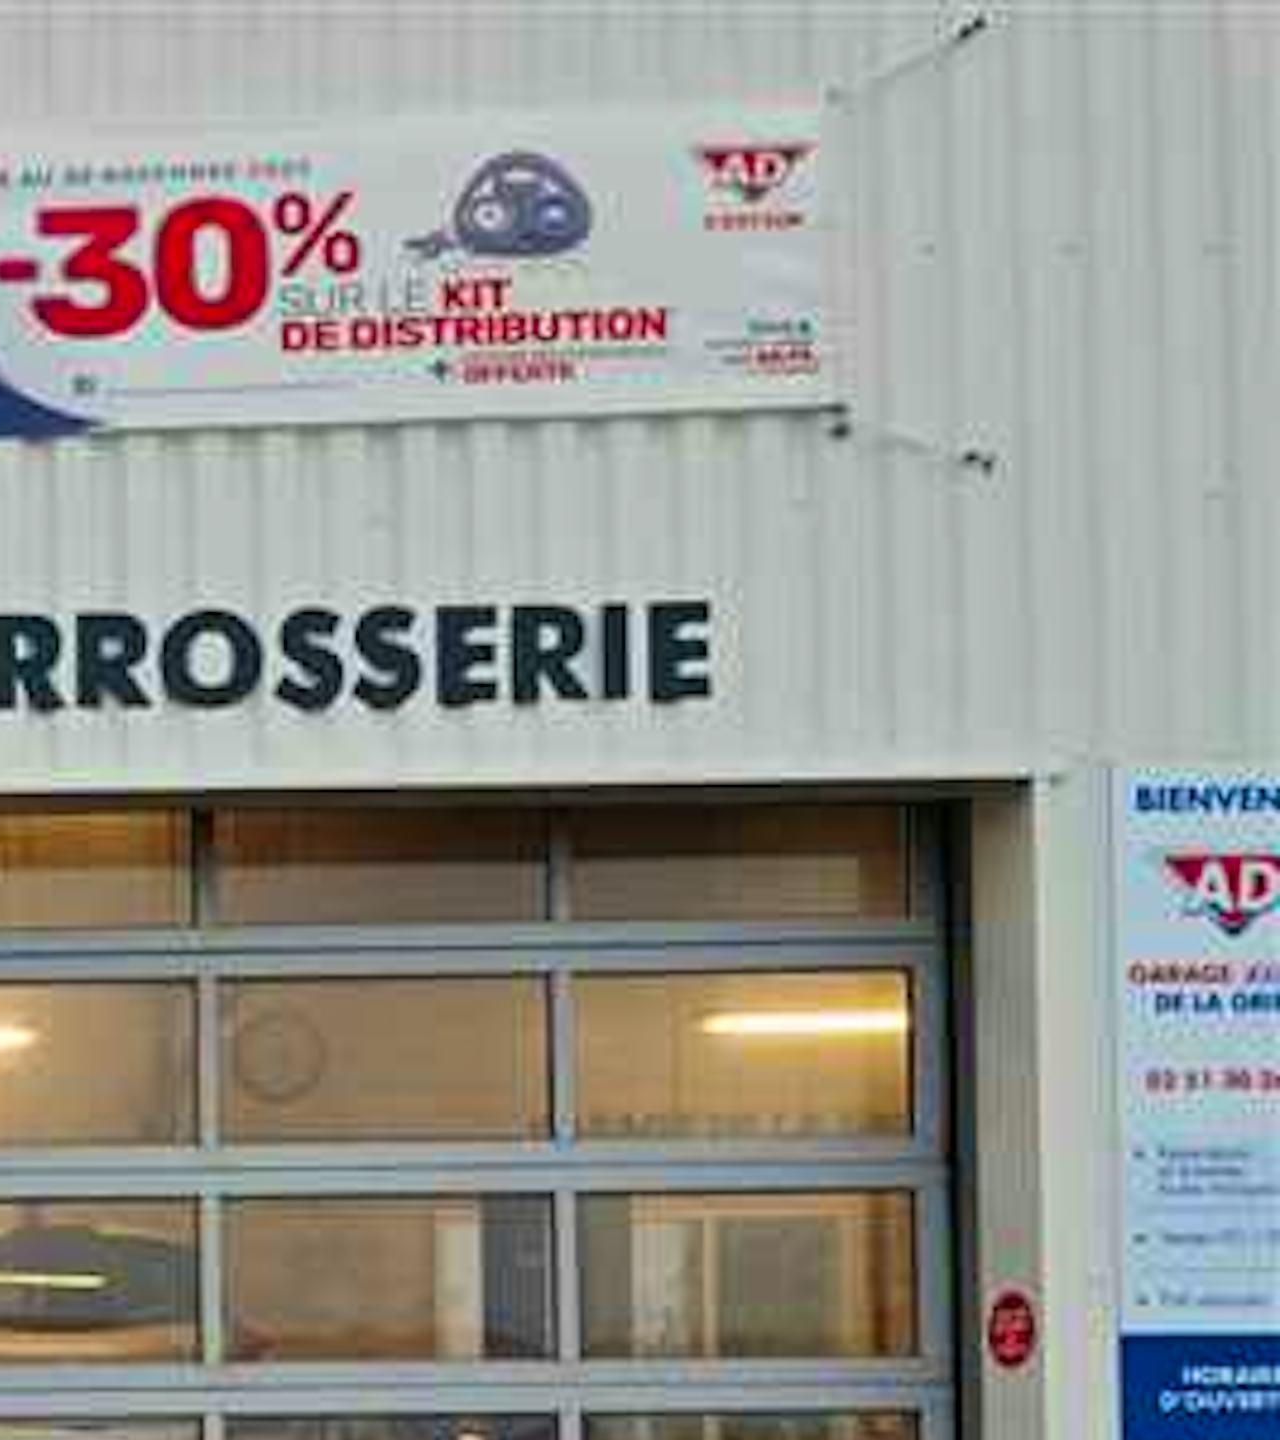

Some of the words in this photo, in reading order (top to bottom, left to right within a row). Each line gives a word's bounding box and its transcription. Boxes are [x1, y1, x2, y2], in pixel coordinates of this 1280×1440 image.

[708, 152, 786, 186] AD
[280, 281, 367, 313] SUR
[380, 277, 428, 311] LE
[442, 277, 513, 309] KIT
[281, 321, 344, 350] DE
[350, 306, 667, 349] DISTRIBUTION
[1197, 859, 1276, 913] AD
[1128, 963, 1229, 984] GARAGE
[1155, 992, 1182, 1015] DE
[1193, 992, 1222, 1013] LA
